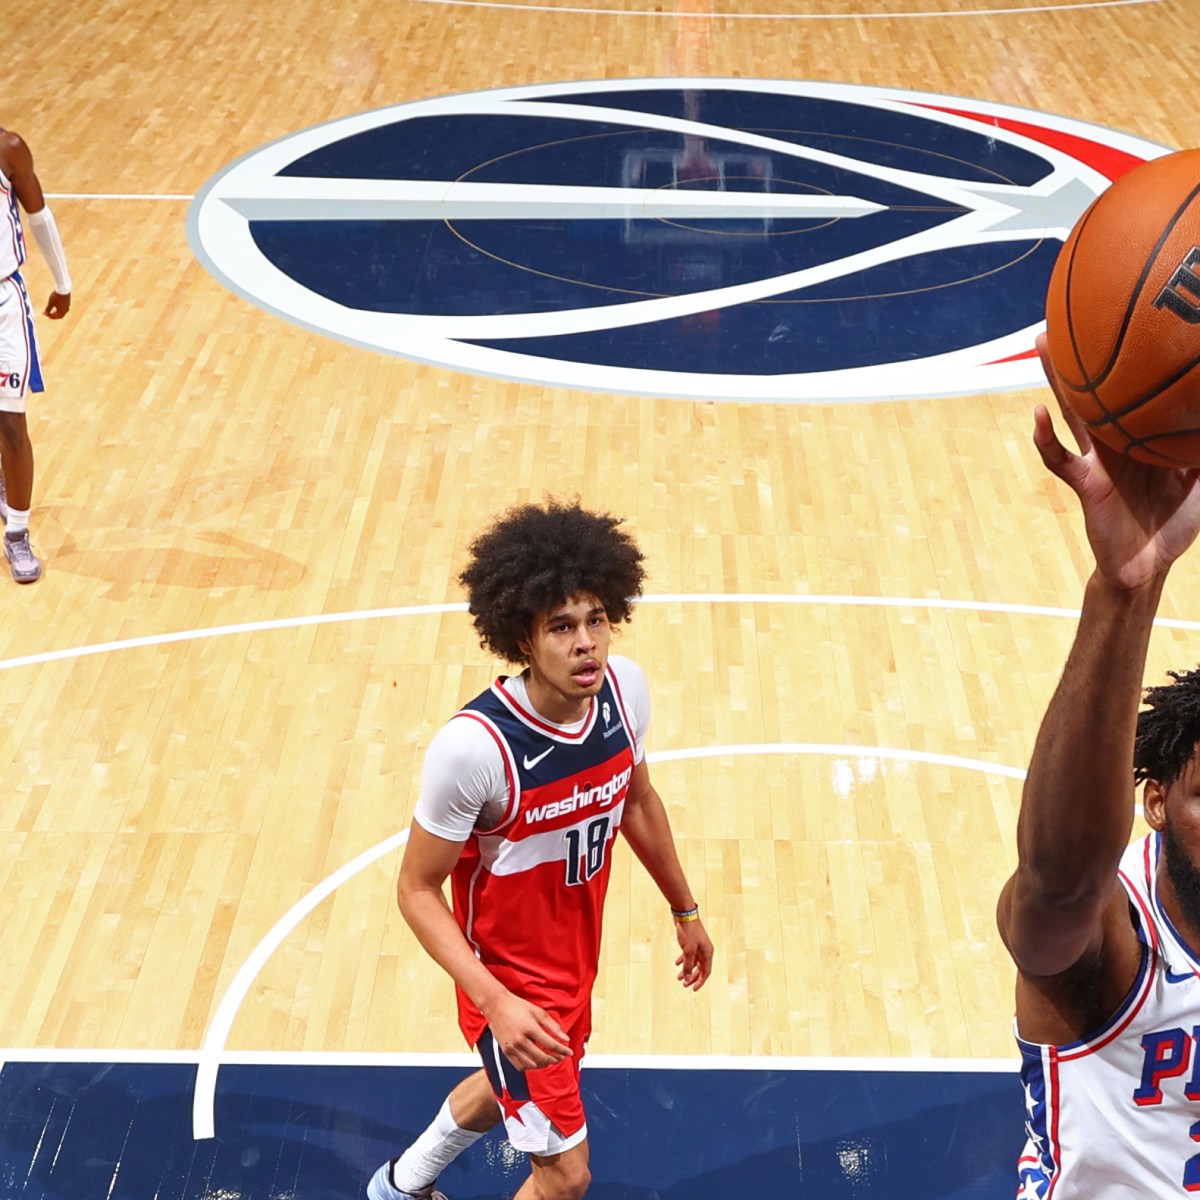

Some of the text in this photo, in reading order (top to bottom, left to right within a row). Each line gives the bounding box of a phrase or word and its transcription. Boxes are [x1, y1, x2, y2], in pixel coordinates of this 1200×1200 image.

[0, 371, 21, 389] 76
[525, 766, 632, 825] washington
[564, 816, 610, 886] 18
